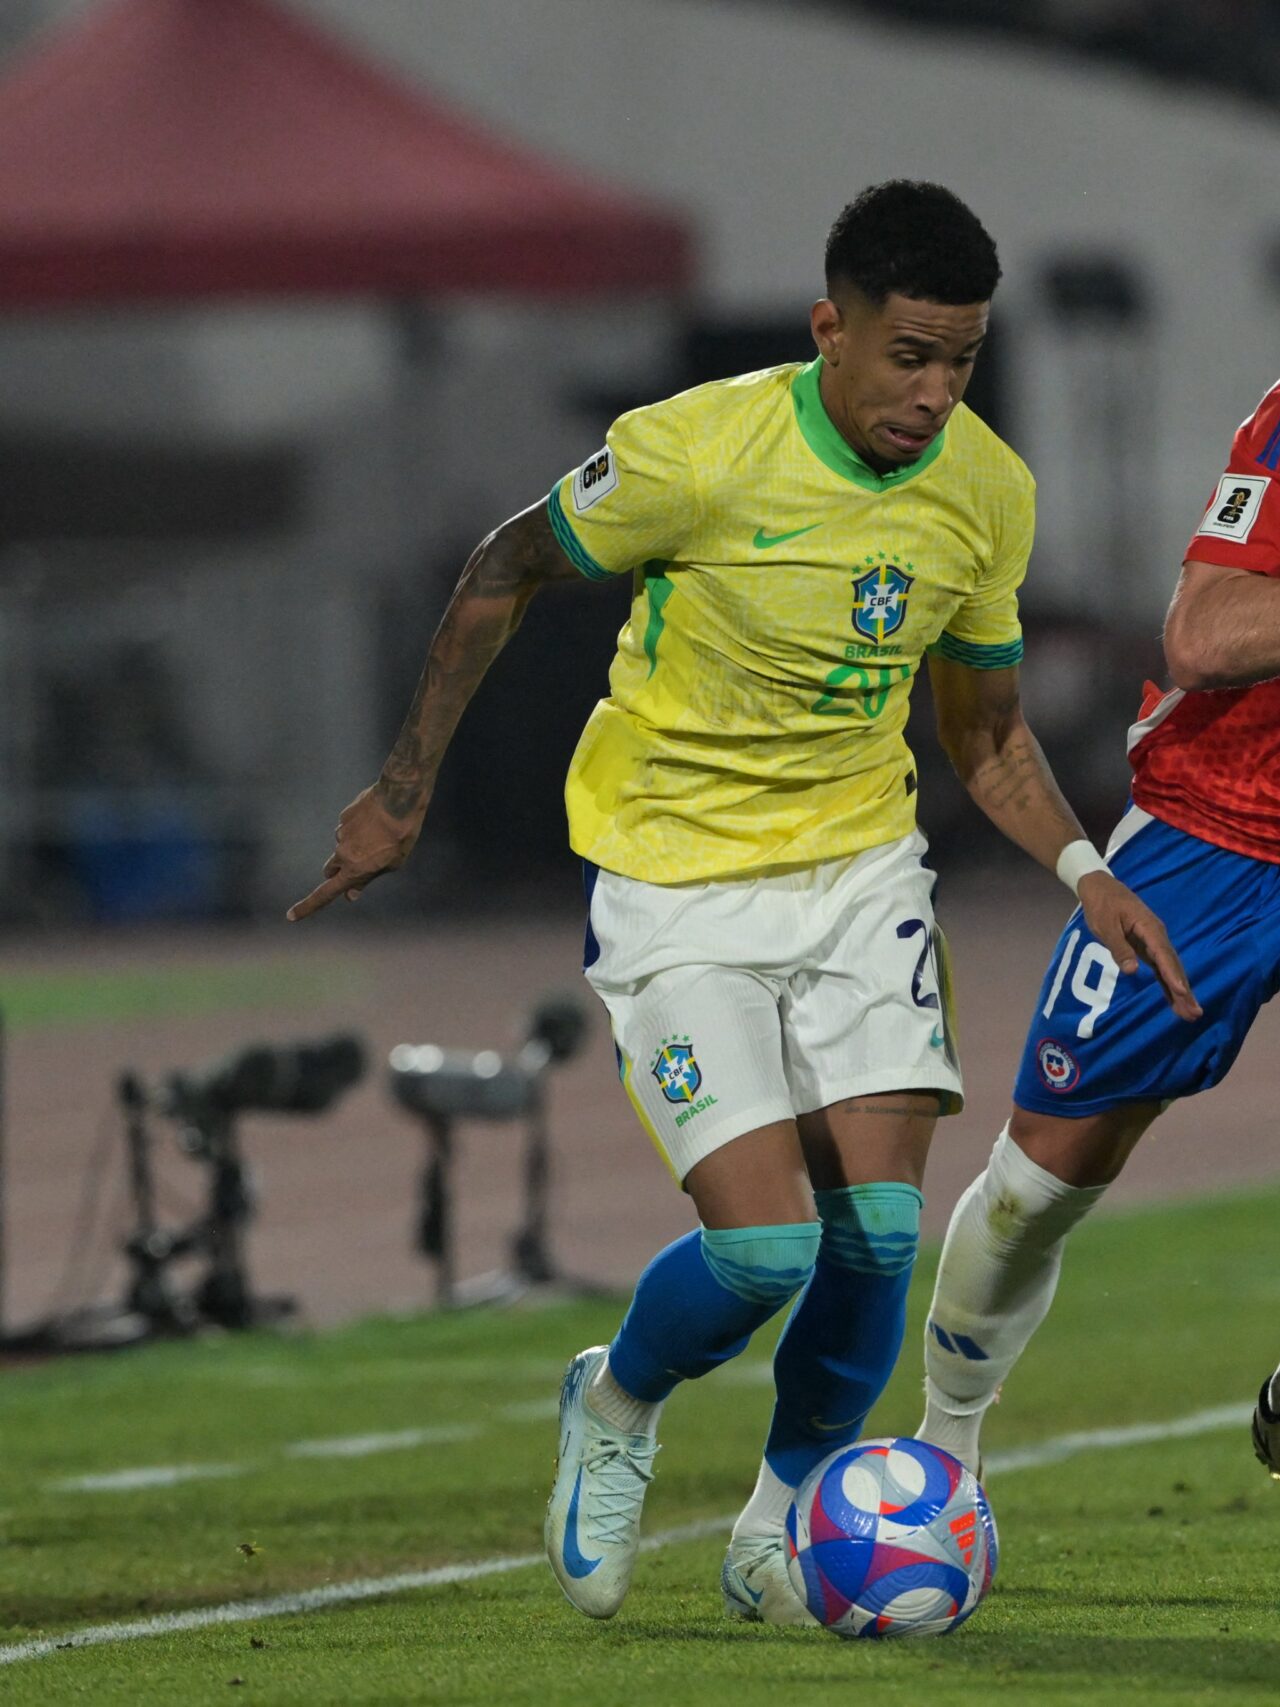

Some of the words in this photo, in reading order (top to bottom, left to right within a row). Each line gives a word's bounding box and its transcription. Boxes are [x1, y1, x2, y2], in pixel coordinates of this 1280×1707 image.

[869, 596, 893, 607] CBF
[844, 645, 903, 660] BRASIL
[896, 918, 940, 1010] 2
[1042, 928, 1121, 1039] 19
[668, 1065, 685, 1080] CBF
[675, 1094, 718, 1128] BRASIL
